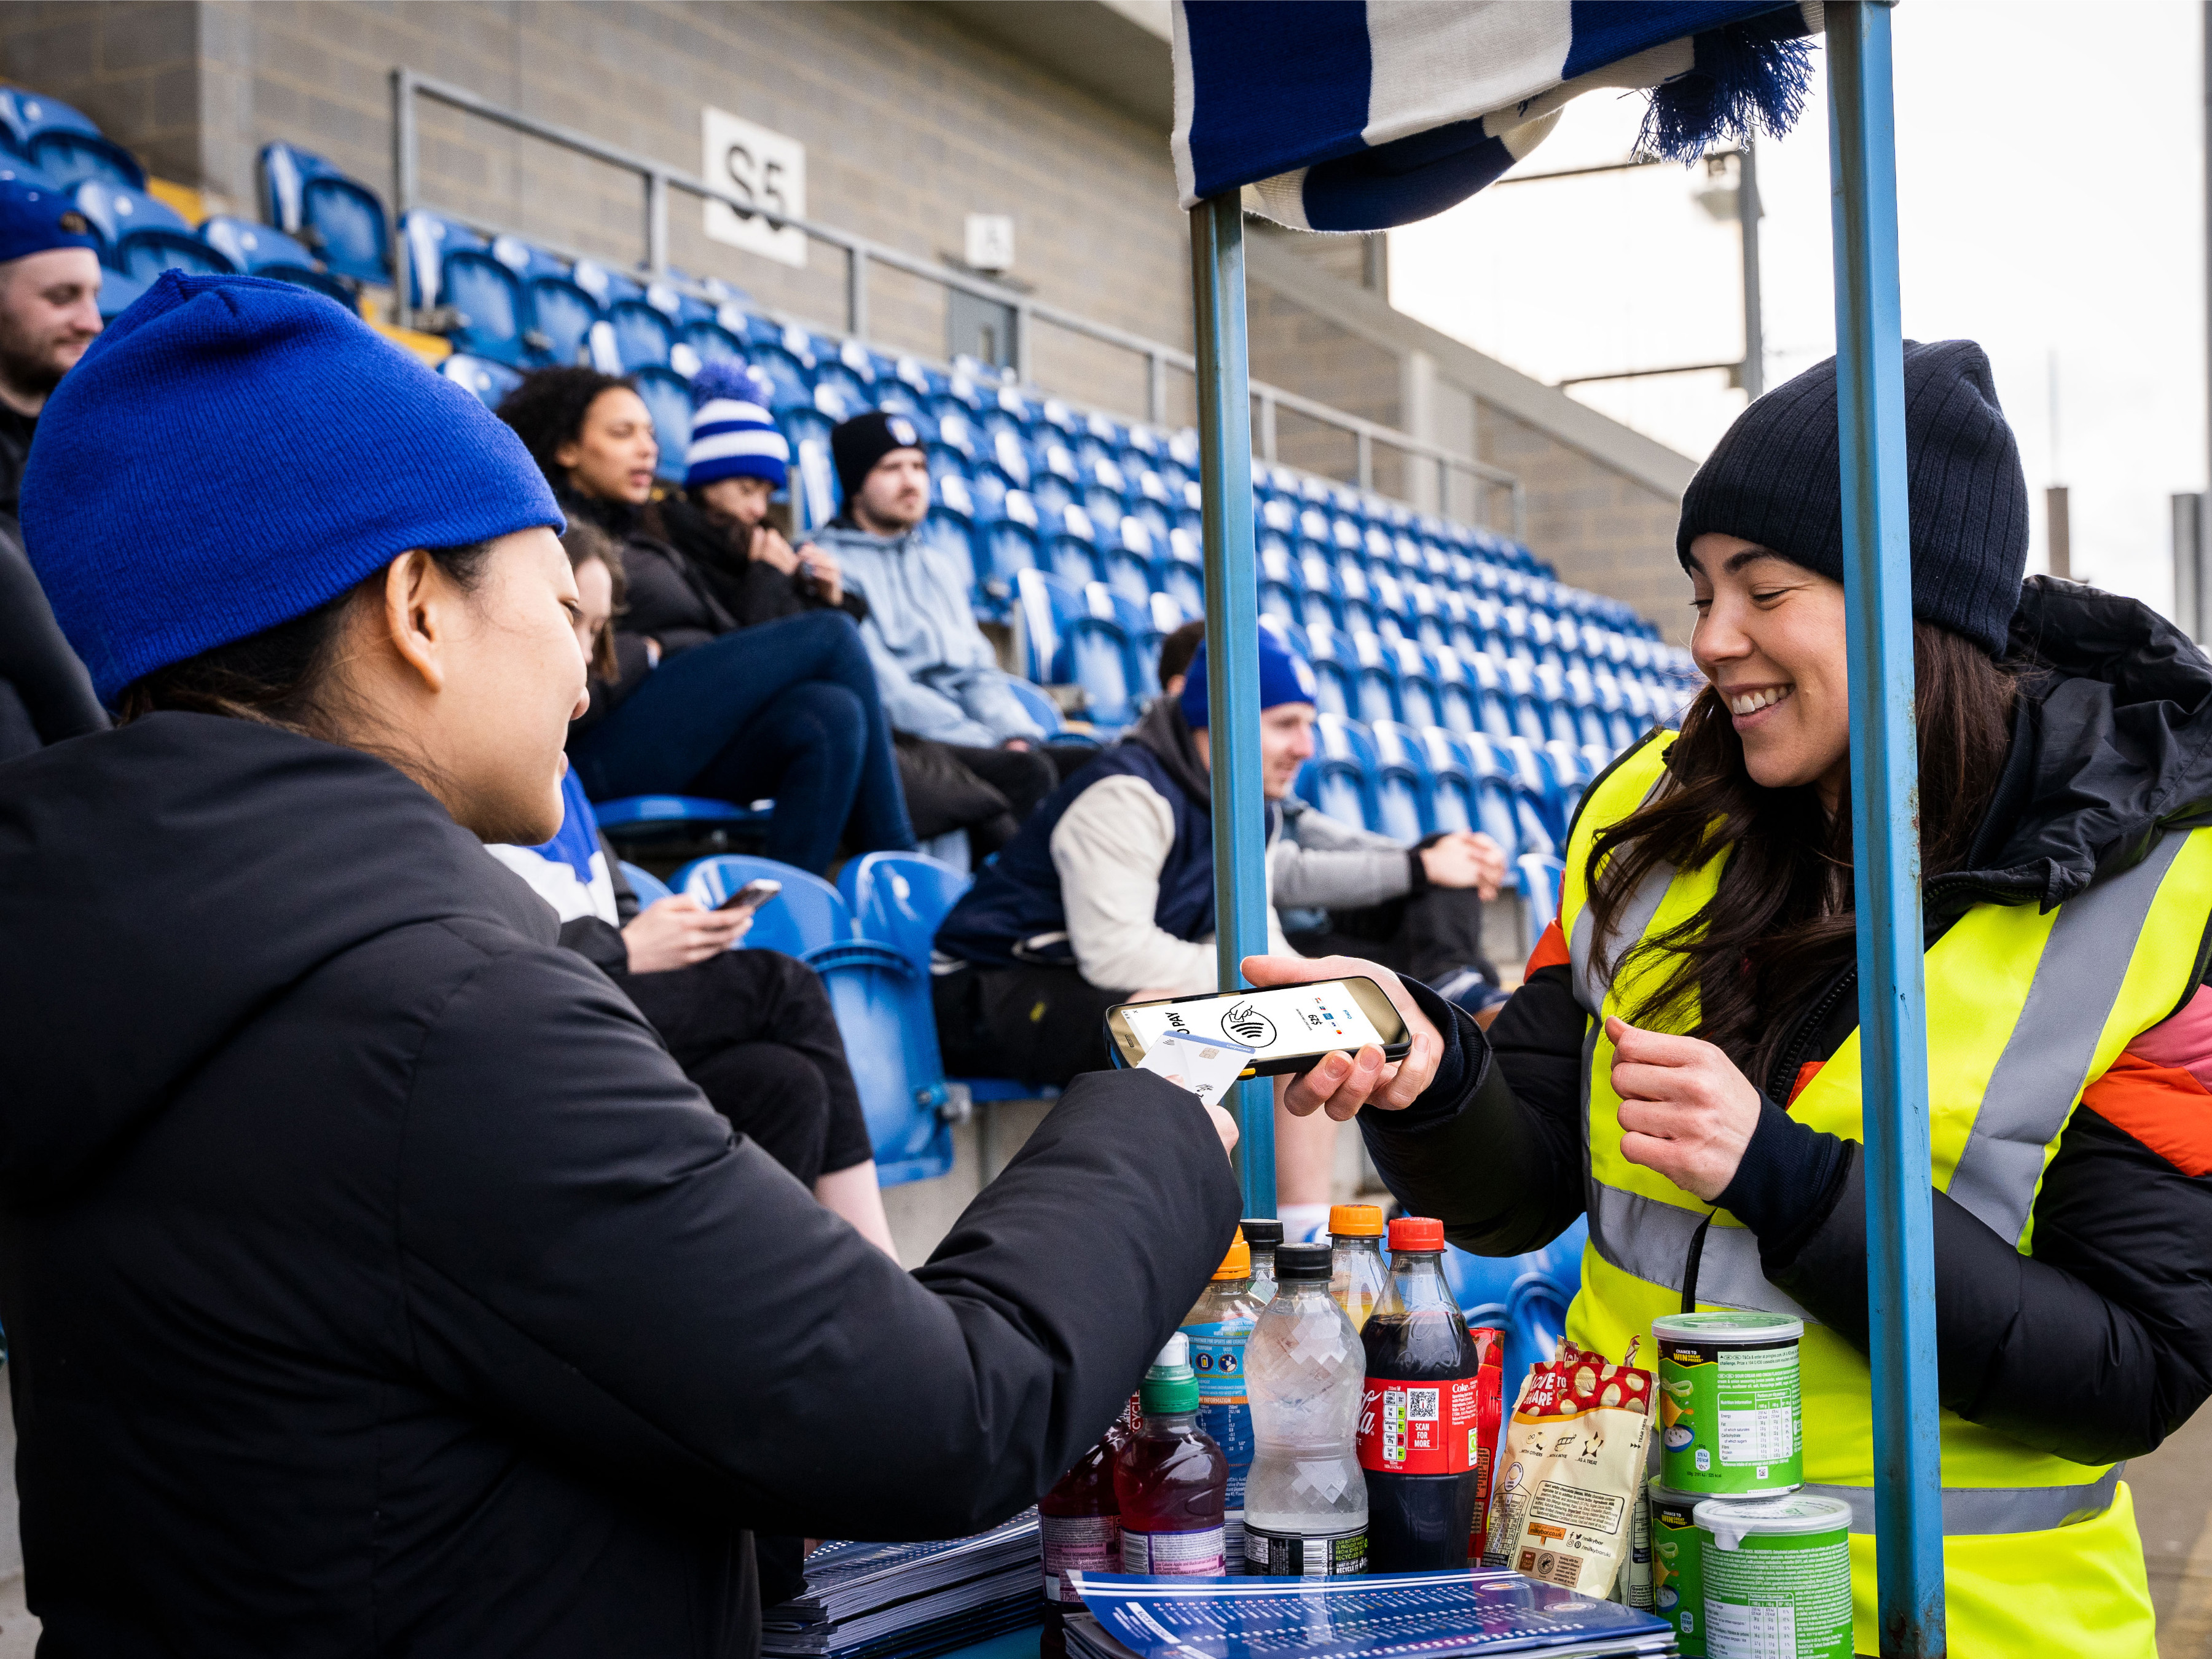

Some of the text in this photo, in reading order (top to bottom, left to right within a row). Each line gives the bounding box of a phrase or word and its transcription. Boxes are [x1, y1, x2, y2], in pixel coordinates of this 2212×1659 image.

[725, 142, 786, 231] S5
[1165, 1012, 1185, 1027] PAY
[1308, 1014, 1323, 1025] $29
[1673, 1353, 1688, 1362] WIN
[1557, 1376, 1567, 1387] TO
[1452, 1383, 1469, 1393] Coke
[1132, 1389, 1141, 1430] CYCLE
[1661, 1514, 1673, 1523] WIN
[1530, 1528, 1562, 1537] milkybar.co.uk
[1582, 1536, 1604, 1545] /milkybar
[1336, 1552, 1359, 1561] RECYCLED
[1336, 1565, 1354, 1574] RECYCLE
